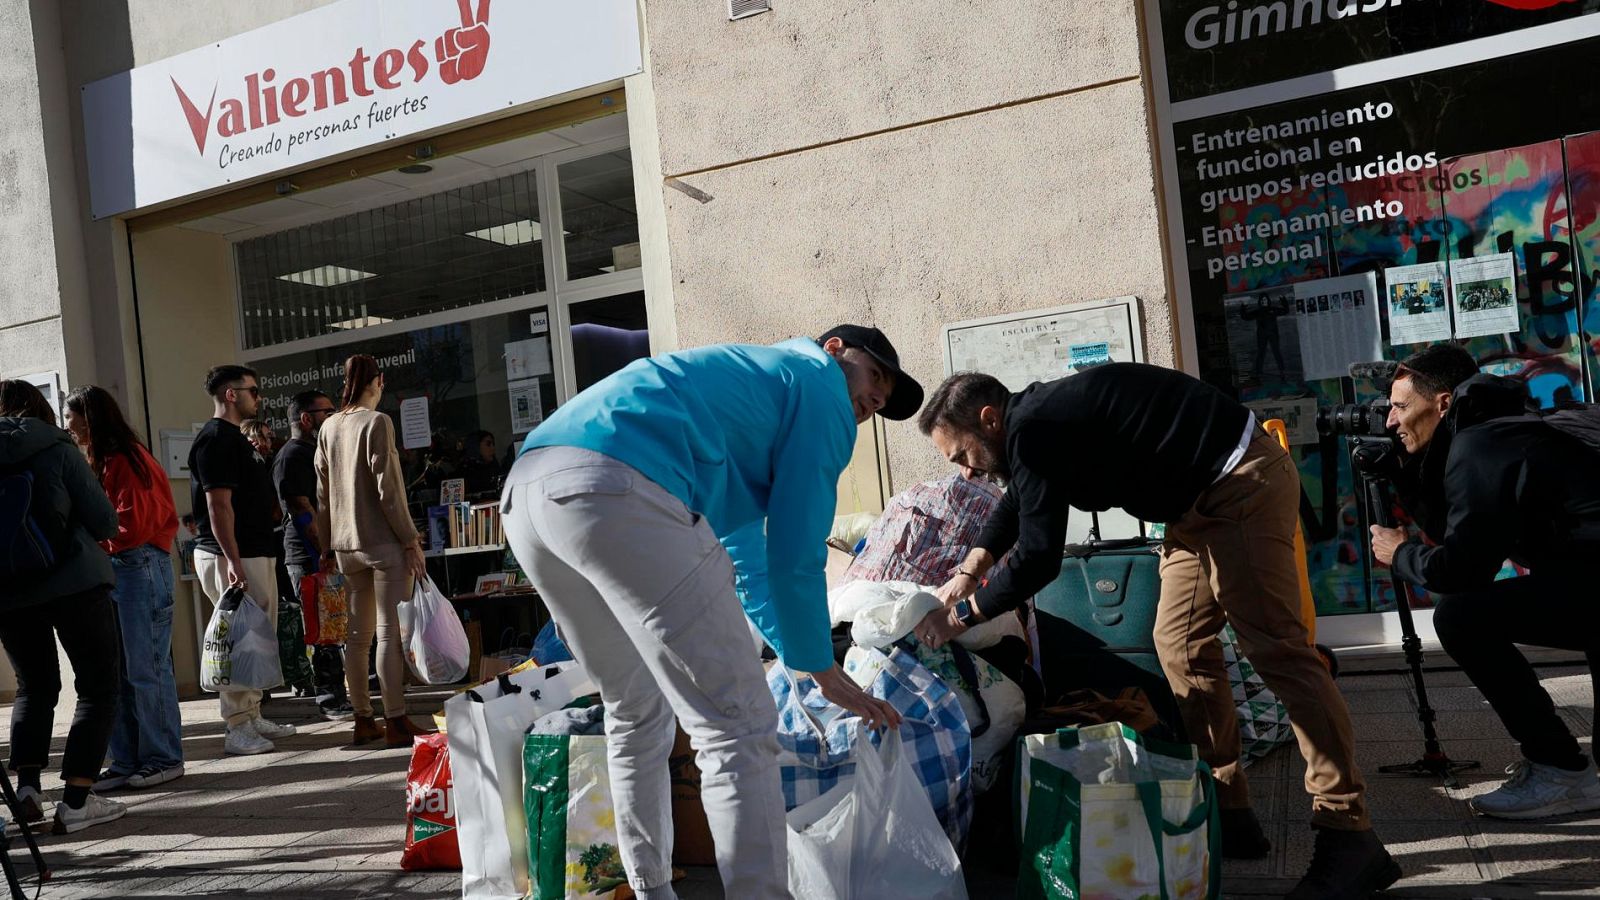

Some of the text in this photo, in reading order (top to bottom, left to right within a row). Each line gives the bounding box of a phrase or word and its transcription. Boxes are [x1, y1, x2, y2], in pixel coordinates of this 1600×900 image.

[169, 39, 429, 157] Valientes
[218, 95, 429, 169] Creando personas fuertes
[1192, 101, 1394, 154] Entrenamiento
[1197, 133, 1362, 180] funcional en
[1200, 150, 1438, 212] grupos reducidos
[1202, 200, 1404, 247] Entrenamiento
[1207, 235, 1322, 279] personal
[532, 319, 546, 327] VISA
[260, 364, 320, 389] Psicología
